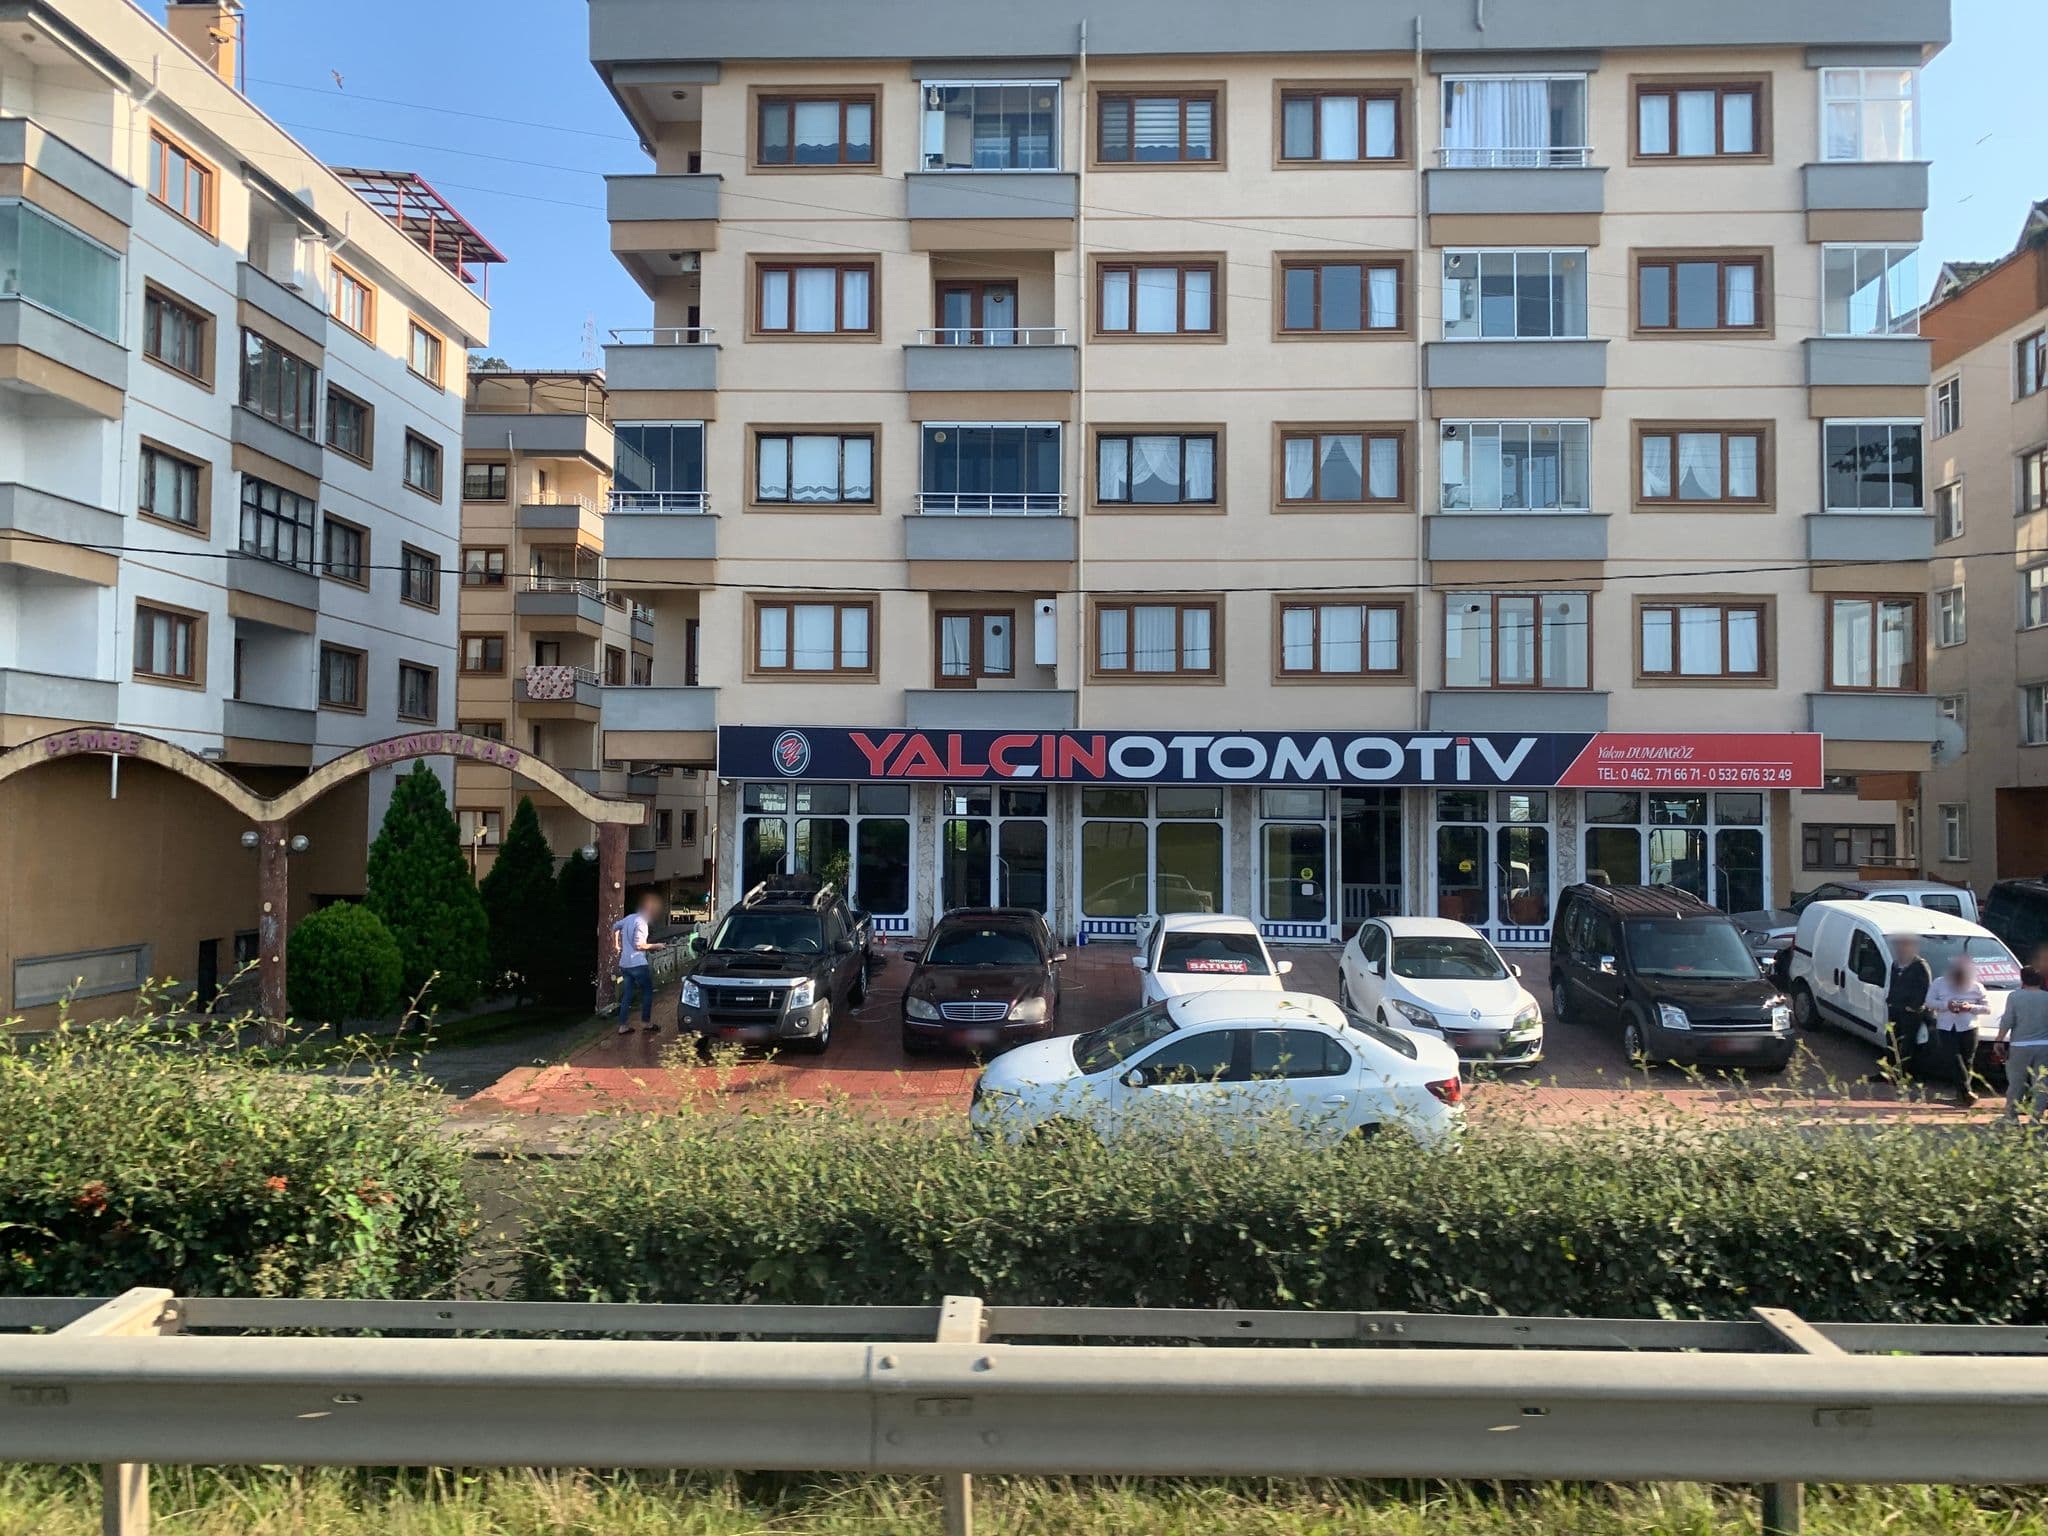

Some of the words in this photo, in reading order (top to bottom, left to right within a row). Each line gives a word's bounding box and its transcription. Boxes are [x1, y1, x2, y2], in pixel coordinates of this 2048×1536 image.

[45, 730, 141, 757] PEMBE
[366, 733, 520, 768] KONUTLAR
[1597, 767, 1619, 780] TEL:
[1621, 767, 1629, 780] 0
[1655, 768, 1672, 780] 771
[1674, 768, 1687, 780] 66
[1689, 768, 1701, 780] 71
[1708, 768, 1716, 780] 0
[1718, 768, 1738, 780] 532
[1740, 768, 1760, 781] 676
[1762, 768, 1776, 781] 32
[1778, 768, 1792, 781] 49
[1190, 962, 1244, 970] SATILIK
